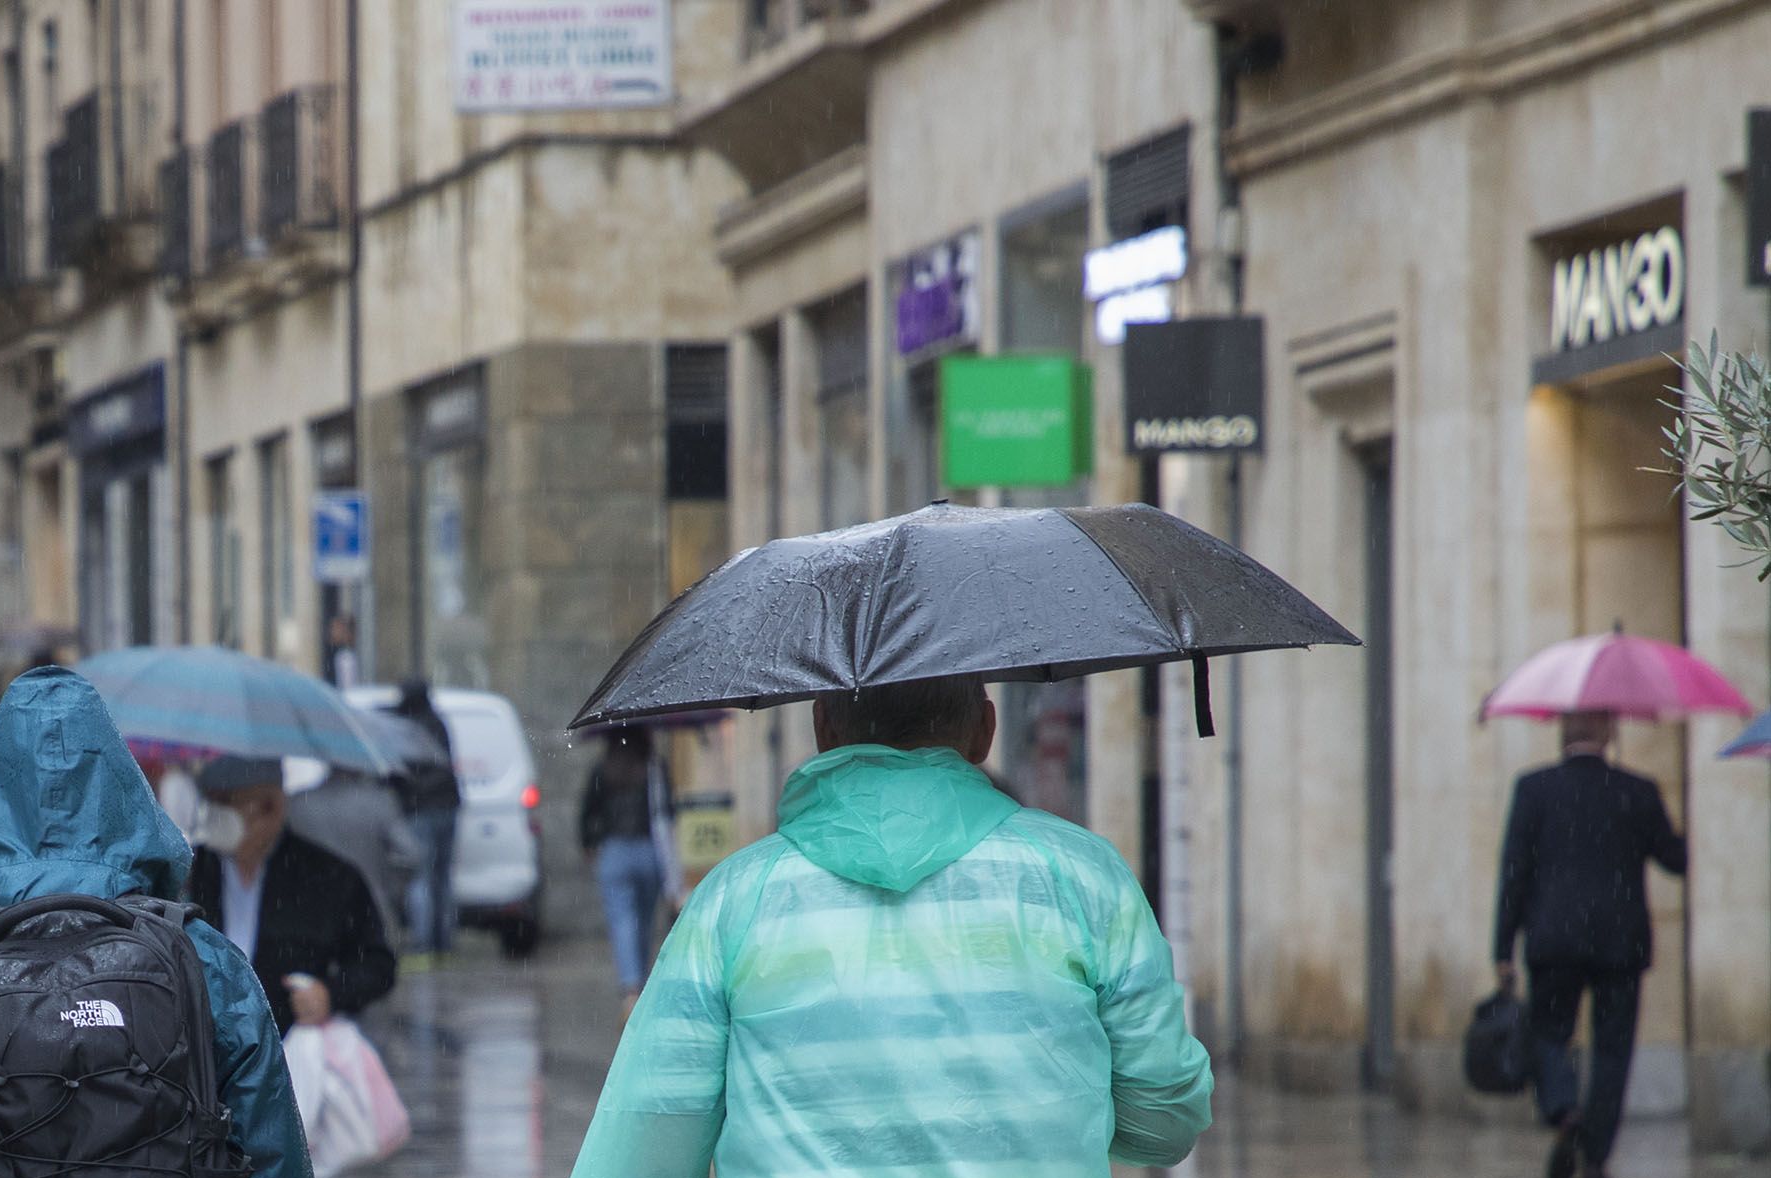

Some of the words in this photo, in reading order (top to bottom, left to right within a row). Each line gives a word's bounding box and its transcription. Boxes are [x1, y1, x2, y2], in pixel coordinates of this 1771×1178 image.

[1550, 225, 1684, 354] MANGO
[1134, 416, 1258, 450] MANGO
[76, 1000, 100, 1010] THE
[60, 1009, 102, 1021] NORTH
[73, 1017, 104, 1028] FACE
